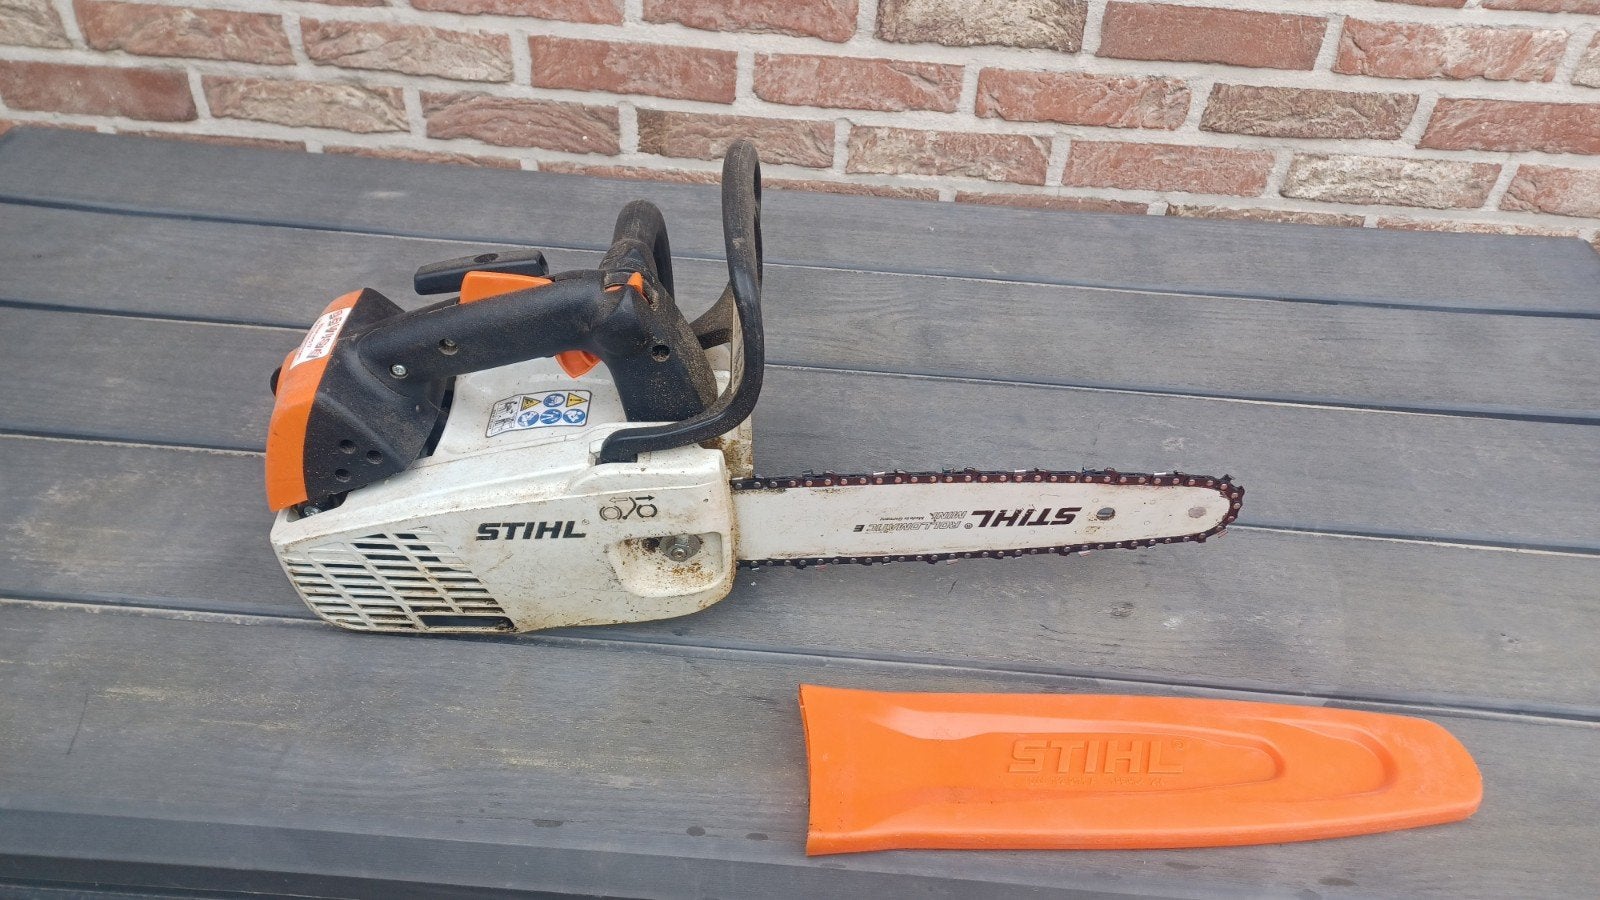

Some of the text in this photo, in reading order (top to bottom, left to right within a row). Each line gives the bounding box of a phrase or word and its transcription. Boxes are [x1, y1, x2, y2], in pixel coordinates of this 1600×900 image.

[971, 506, 1082, 528] STIHL
[475, 520, 587, 541] STIHL
[853, 524, 865, 532] E
[1008, 740, 1185, 774] STIHL
